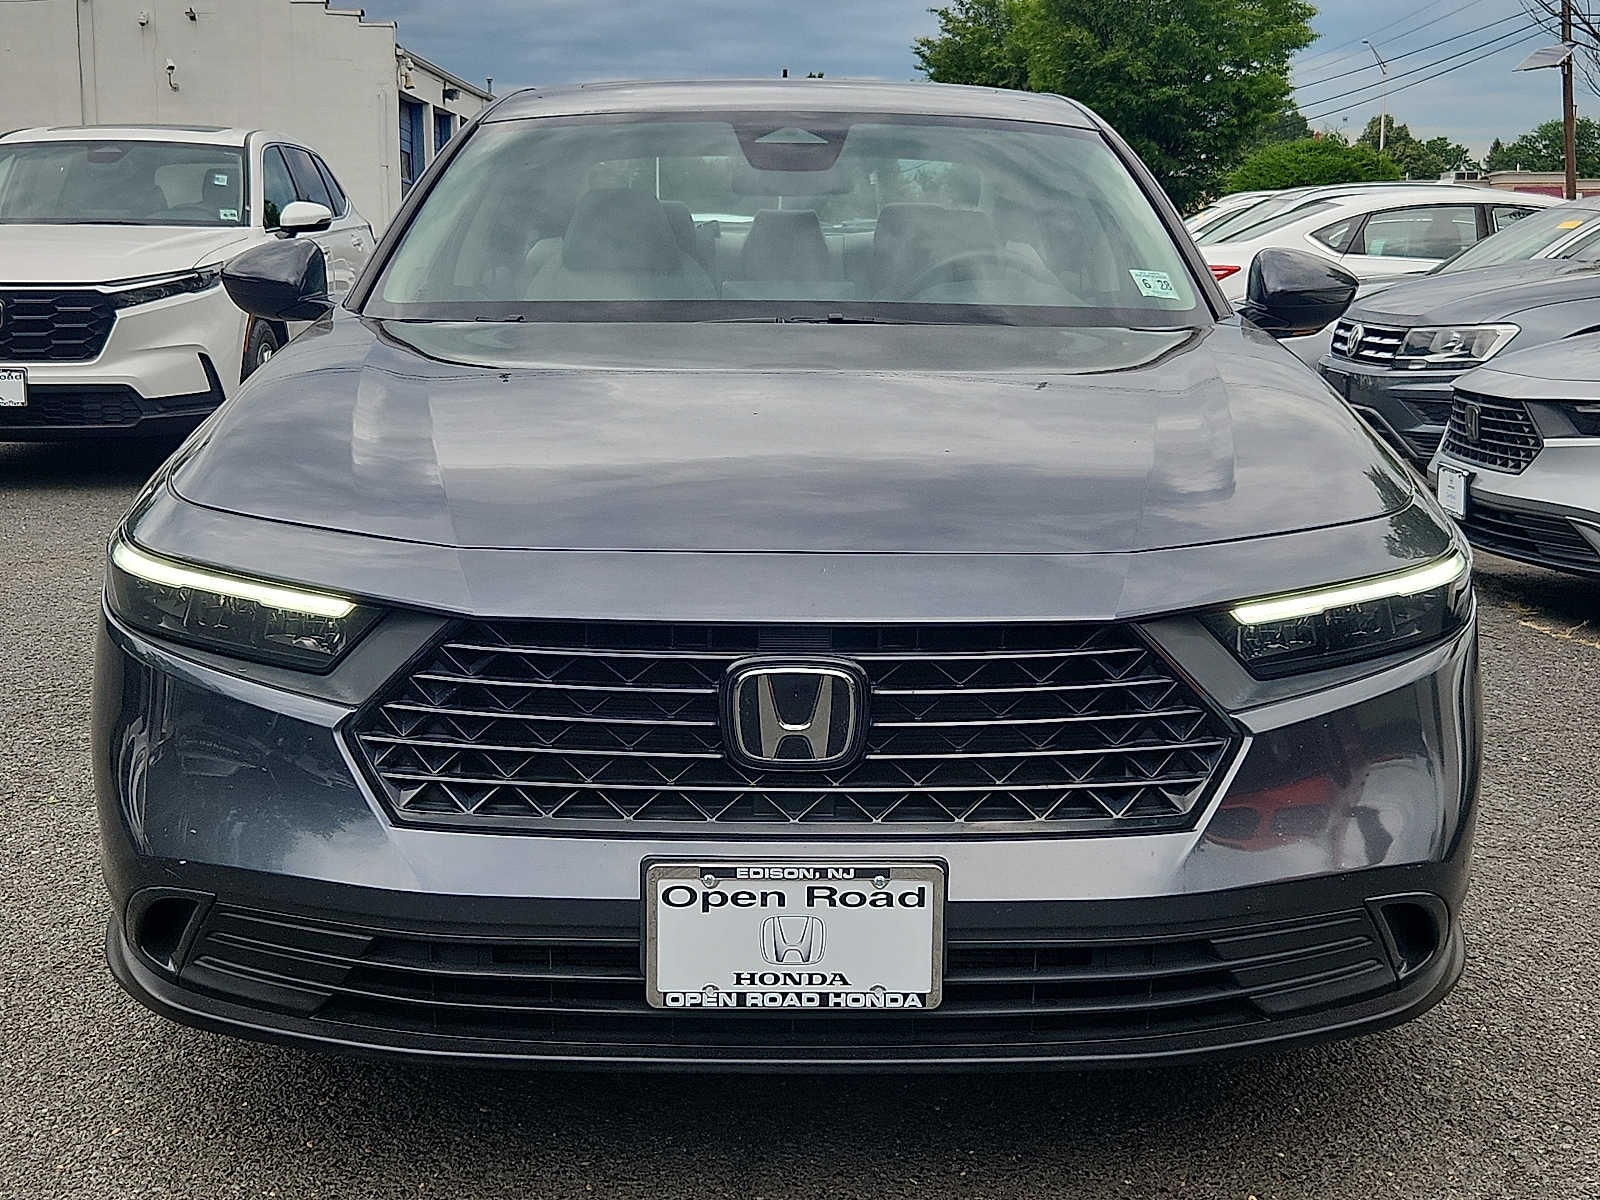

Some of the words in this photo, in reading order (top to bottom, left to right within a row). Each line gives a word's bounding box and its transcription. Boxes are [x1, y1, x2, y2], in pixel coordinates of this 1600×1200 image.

[1141, 278, 1152, 289] 6
[0, 372, 22, 380] oad
[736, 867, 820, 881] EDISON,
[828, 868, 855, 880] NJ
[661, 885, 786, 913] Open
[806, 885, 926, 908] Road
[732, 972, 852, 986] HONDA
[665, 992, 743, 1008] OPEN
[746, 992, 825, 1008] ROAD
[828, 992, 923, 1008] HONDA
